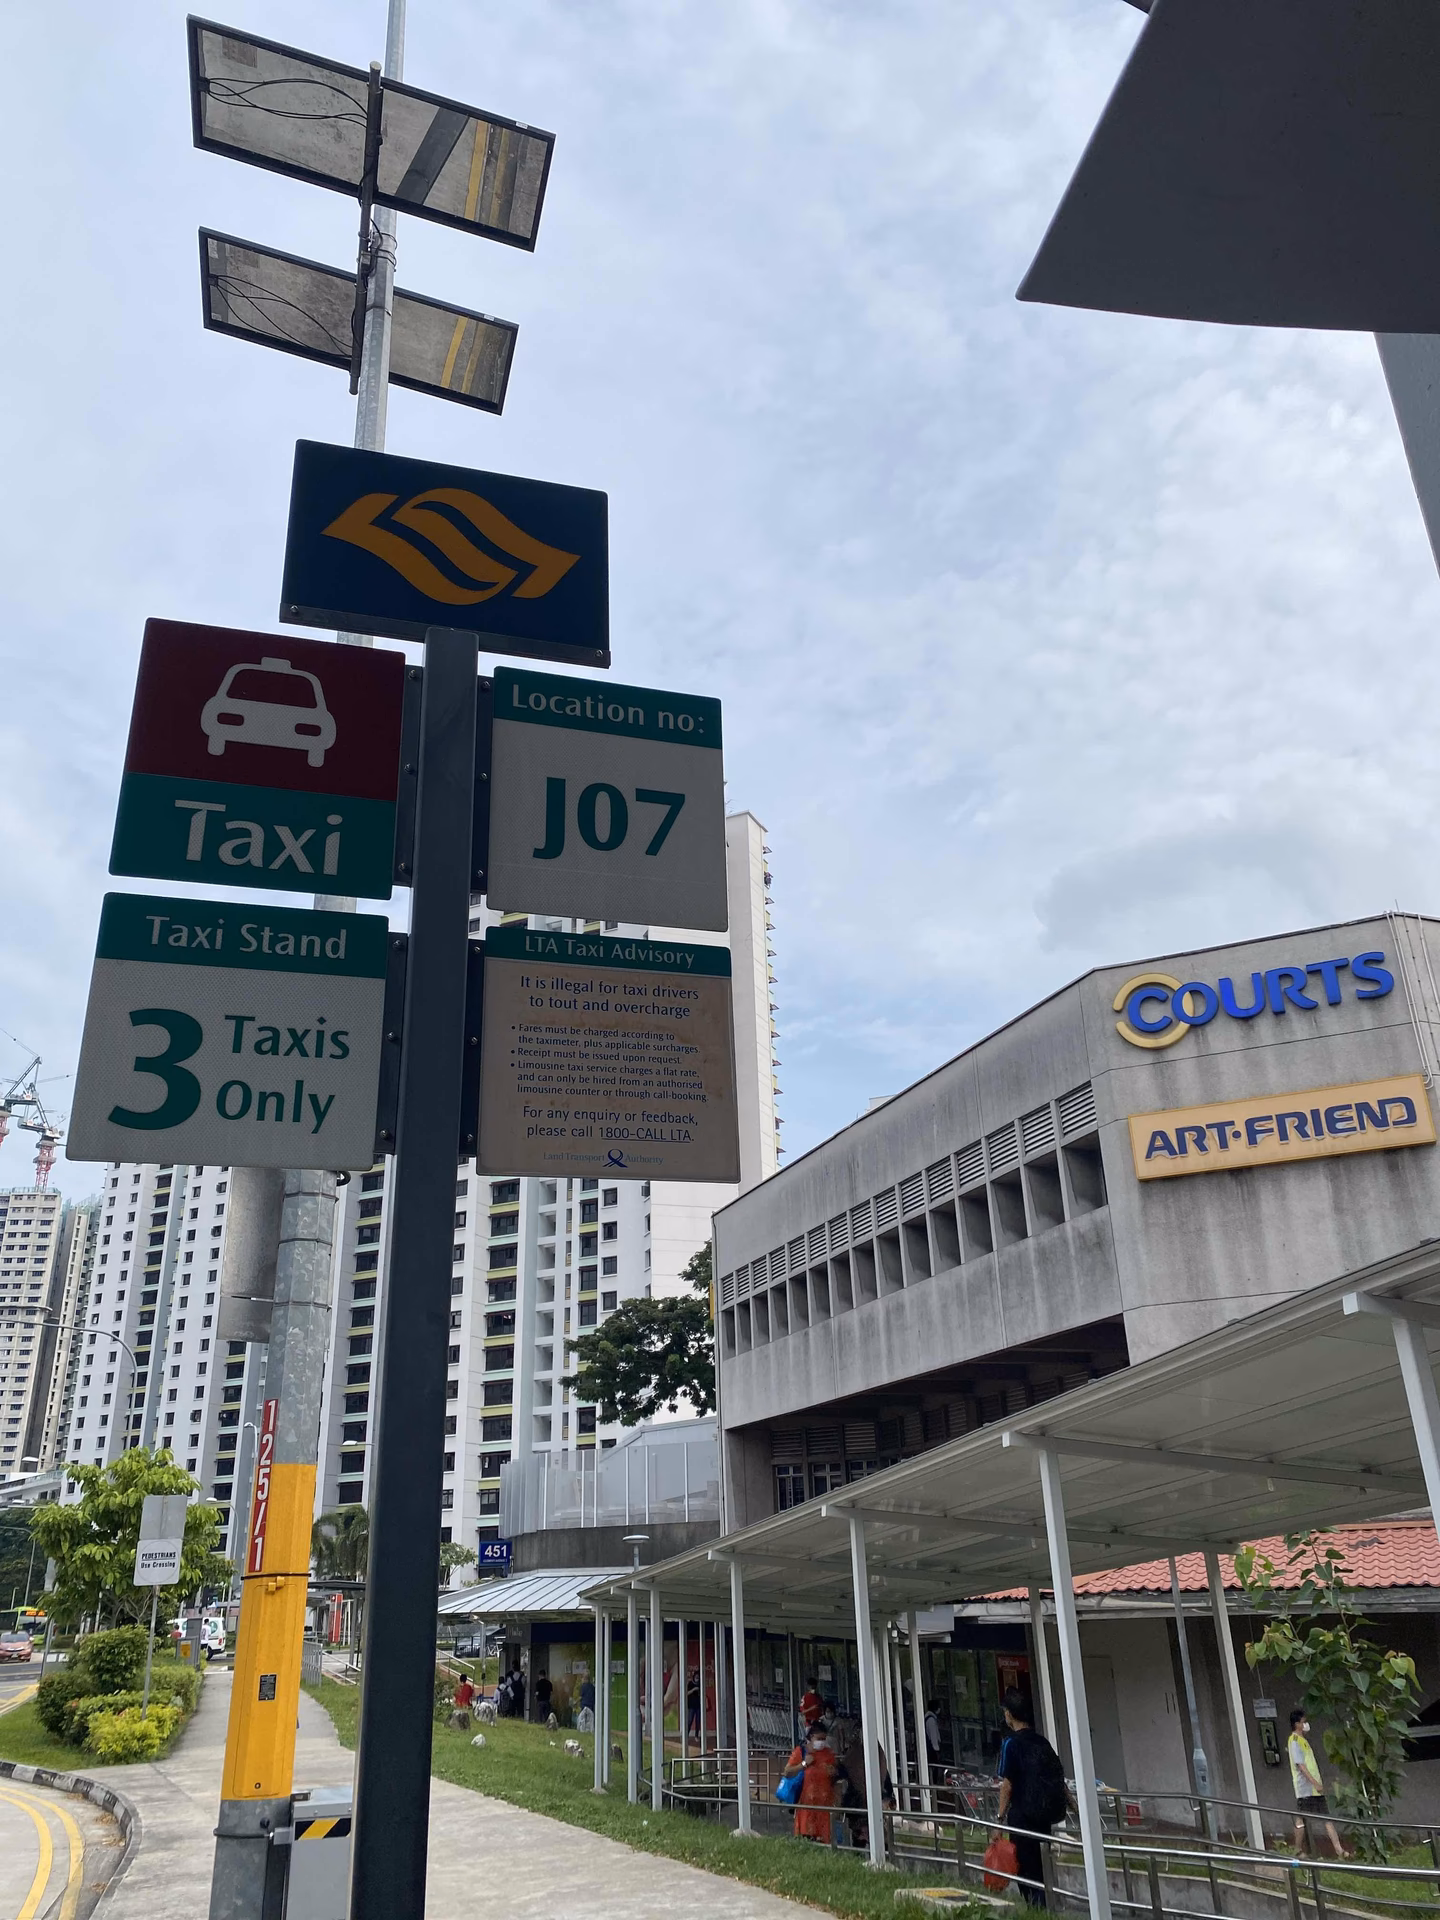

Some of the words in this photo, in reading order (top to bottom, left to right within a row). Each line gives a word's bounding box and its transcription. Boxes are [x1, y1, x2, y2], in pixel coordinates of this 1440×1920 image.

[512, 684, 645, 726] Location
[658, 710, 705, 734] no:
[532, 776, 686, 860] J07
[174, 799, 344, 877] Taxi
[146, 915, 225, 947] Taxi
[239, 923, 348, 960] Stand
[525, 935, 559, 954] LTA
[564, 938, 604, 958] Taxi
[611, 943, 695, 969] Advisory
[521, 975, 531, 988] It
[536, 976, 546, 990] is
[551, 977, 593, 995] illegal
[599, 981, 618, 994] for
[622, 984, 648, 997] taxi
[652, 985, 699, 1000] drivers
[1127, 951, 1395, 1033] COURTS
[529, 995, 544, 1008] to
[549, 996, 578, 1010] tout
[582, 999, 609, 1012] and
[614, 1002, 691, 1020] overcharge
[225, 1014, 350, 1060] Taxis
[518, 1023, 542, 1033] Fares
[545, 1026, 568, 1035] must
[570, 1026, 581, 1035] be
[583, 1027, 619, 1039] charged
[621, 1031, 664, 1042] according
[666, 1032, 675, 1041] to
[518, 1035, 534, 1044] the
[584, 1039, 602, 1049] plus
[605, 1040, 650, 1051] applicable
[517, 1047, 551, 1059] Receipt
[553, 1050, 576, 1059] must
[579, 1050, 590, 1060] be
[592, 1051, 620, 1061] issued
[622, 1054, 645, 1063] upon
[108, 1007, 204, 1130] 3
[518, 1060, 565, 1071] Limousine
[567, 1063, 584, 1072] taxi
[586, 1064, 617, 1074] service
[620, 1065, 653, 1076] charges
[655, 1068, 661, 1076] a
[663, 1067, 678, 1077] flat
[517, 1072, 535, 1082] and
[537, 1074, 554, 1083] can
[556, 1074, 576, 1084] only
[579, 1075, 590, 1084] be
[592, 1076, 616, 1085] hired
[619, 1077, 640, 1087] from
[642, 1079, 654, 1087] an
[656, 1080, 703, 1090] authorised
[517, 1084, 563, 1095] limousine
[565, 1087, 600, 1097] counter
[602, 1089, 613, 1097] or
[615, 1088, 650, 1100] through
[215, 1079, 335, 1135] Only
[523, 1105, 543, 1118] For
[547, 1109, 570, 1122] any
[574, 1109, 620, 1124] enquiry
[624, 1112, 637, 1122] or
[641, 1110, 698, 1126] feedback,
[527, 1124, 567, 1139] please
[571, 1125, 593, 1138] call
[599, 1127, 667, 1141] 1800-CALL
[670, 1129, 695, 1142] LTA.
[543, 1152, 564, 1161] Land
[565, 1152, 605, 1163] Transport
[625, 1154, 664, 1165] Authority
[141, 1552, 176, 1560] PEDESTRIANS
[484, 1544, 507, 1558] 451
